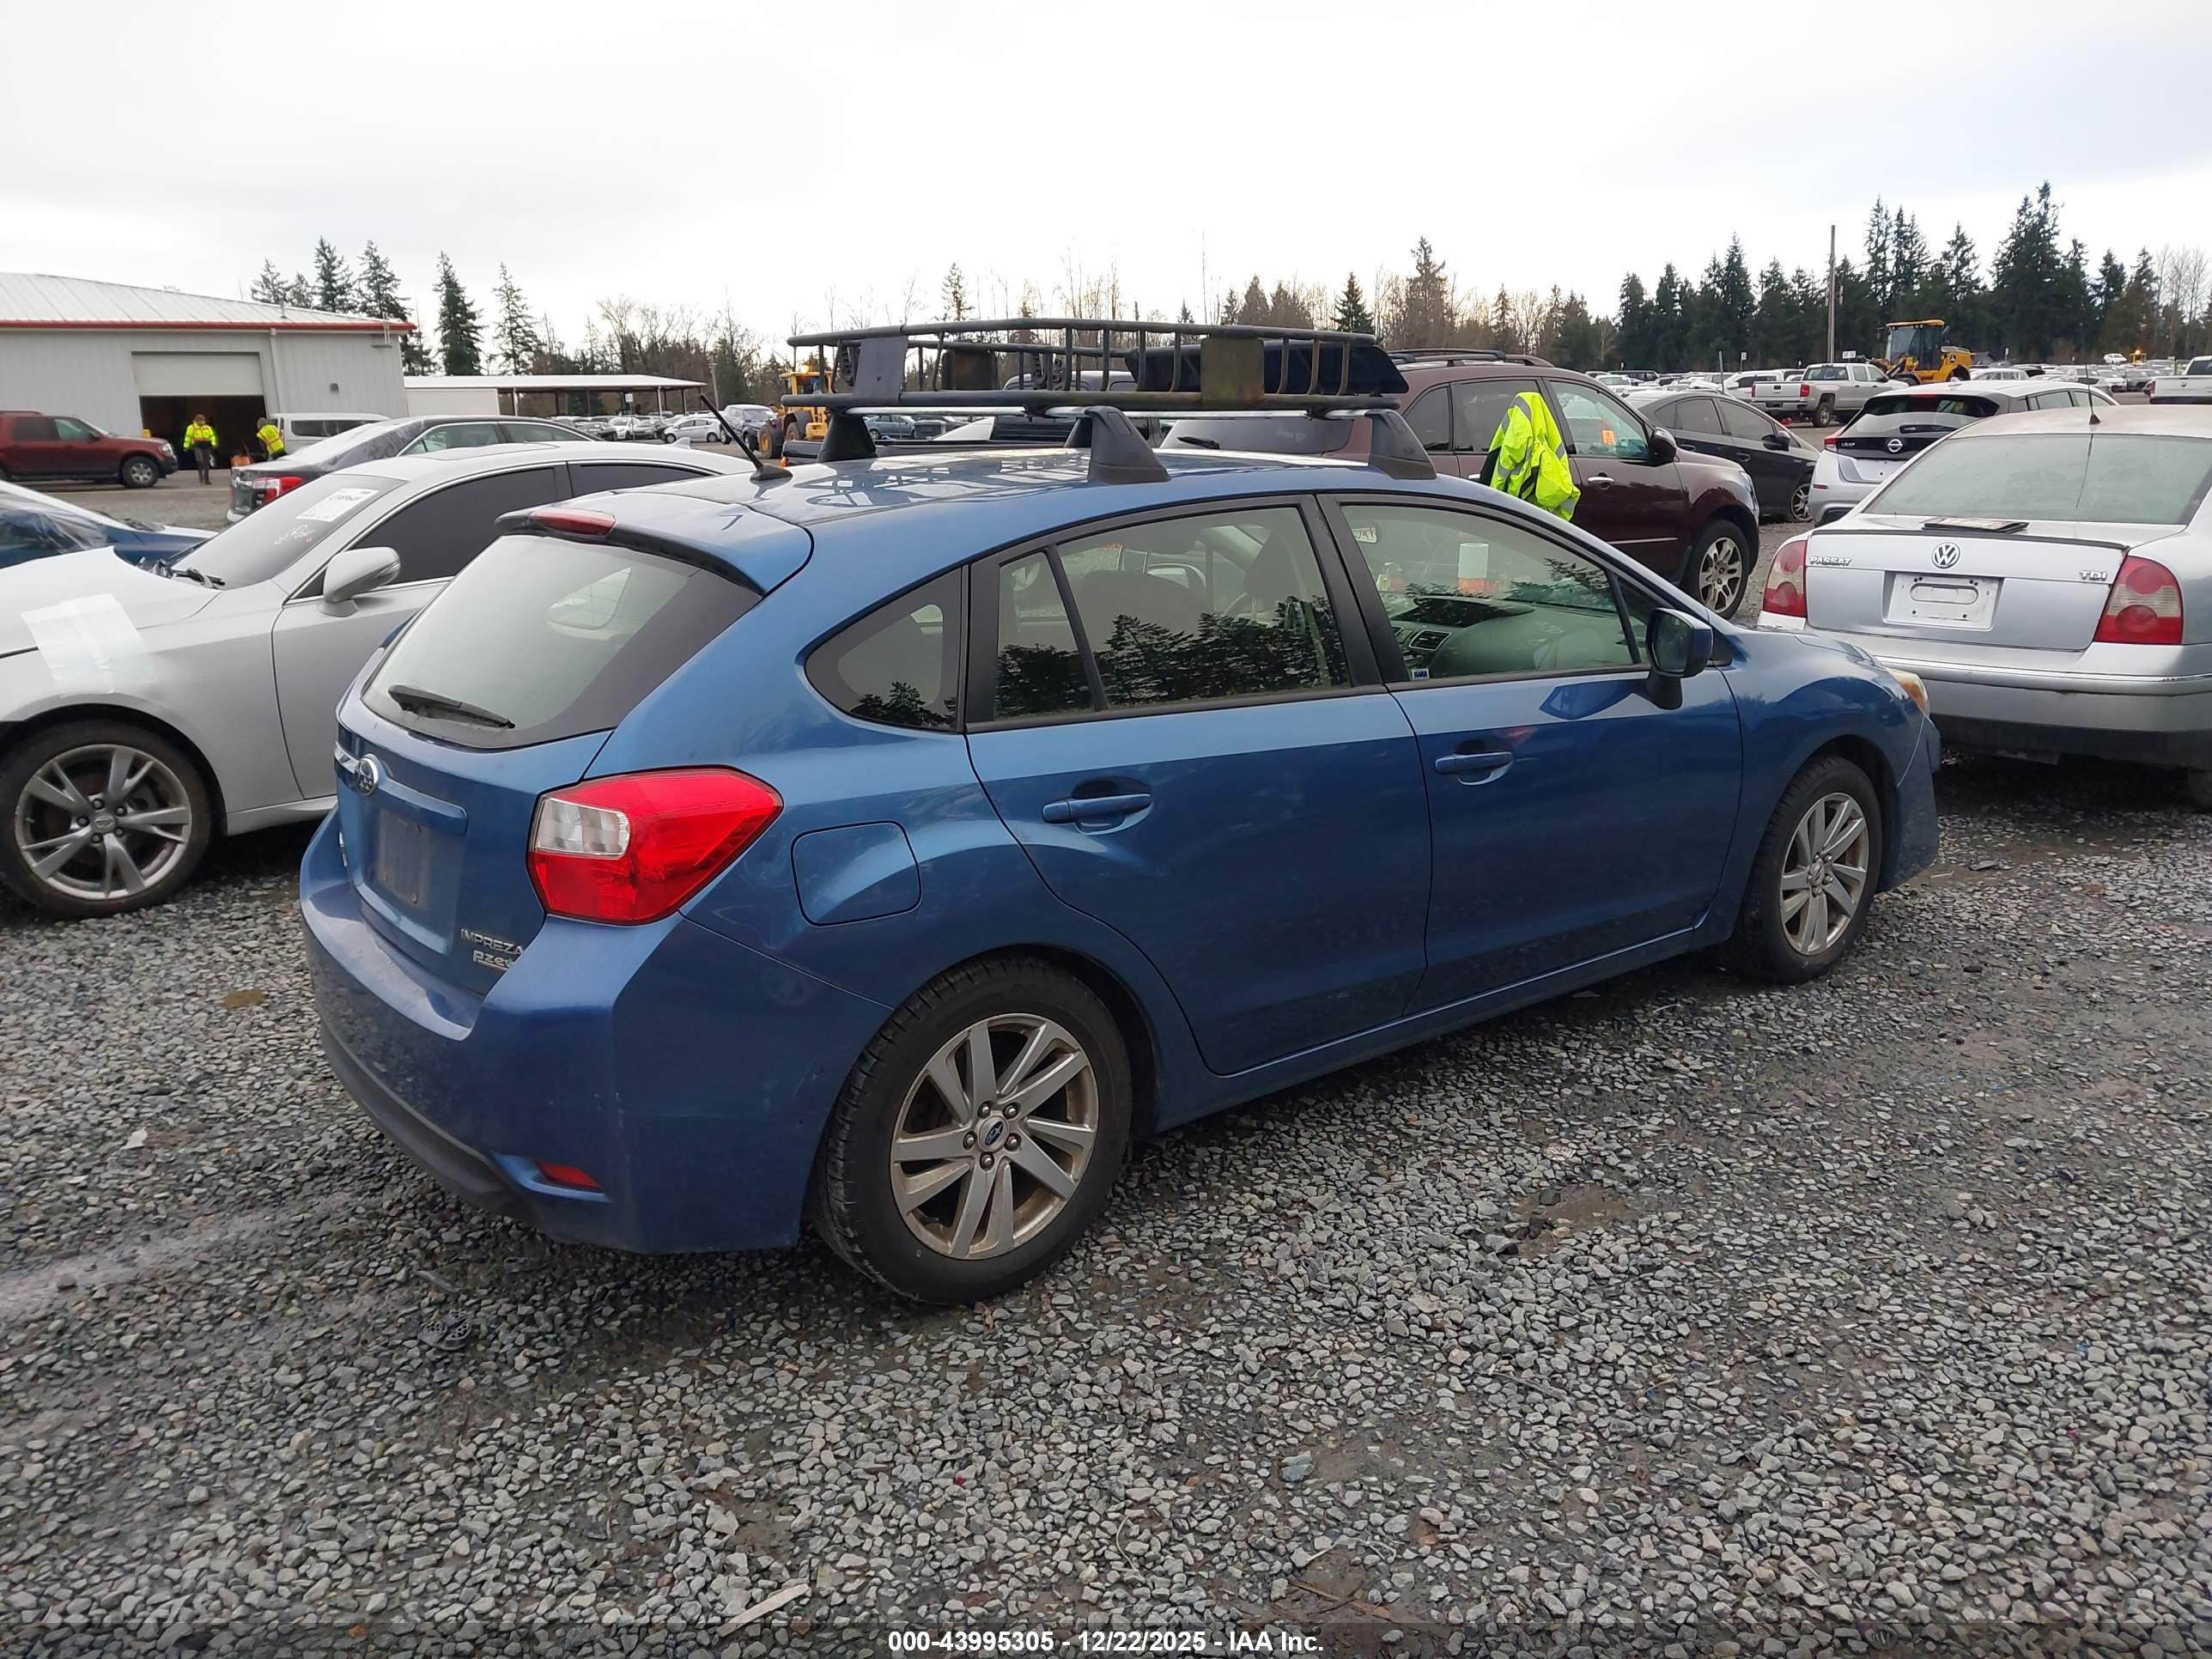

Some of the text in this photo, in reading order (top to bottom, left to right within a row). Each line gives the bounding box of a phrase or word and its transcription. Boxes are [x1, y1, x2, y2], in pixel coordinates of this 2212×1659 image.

[1809, 556, 1852, 566] PASSAT
[1933, 543, 1960, 568] VW
[2079, 570, 2107, 580] TDI
[460, 928, 523, 955] IMPREZA
